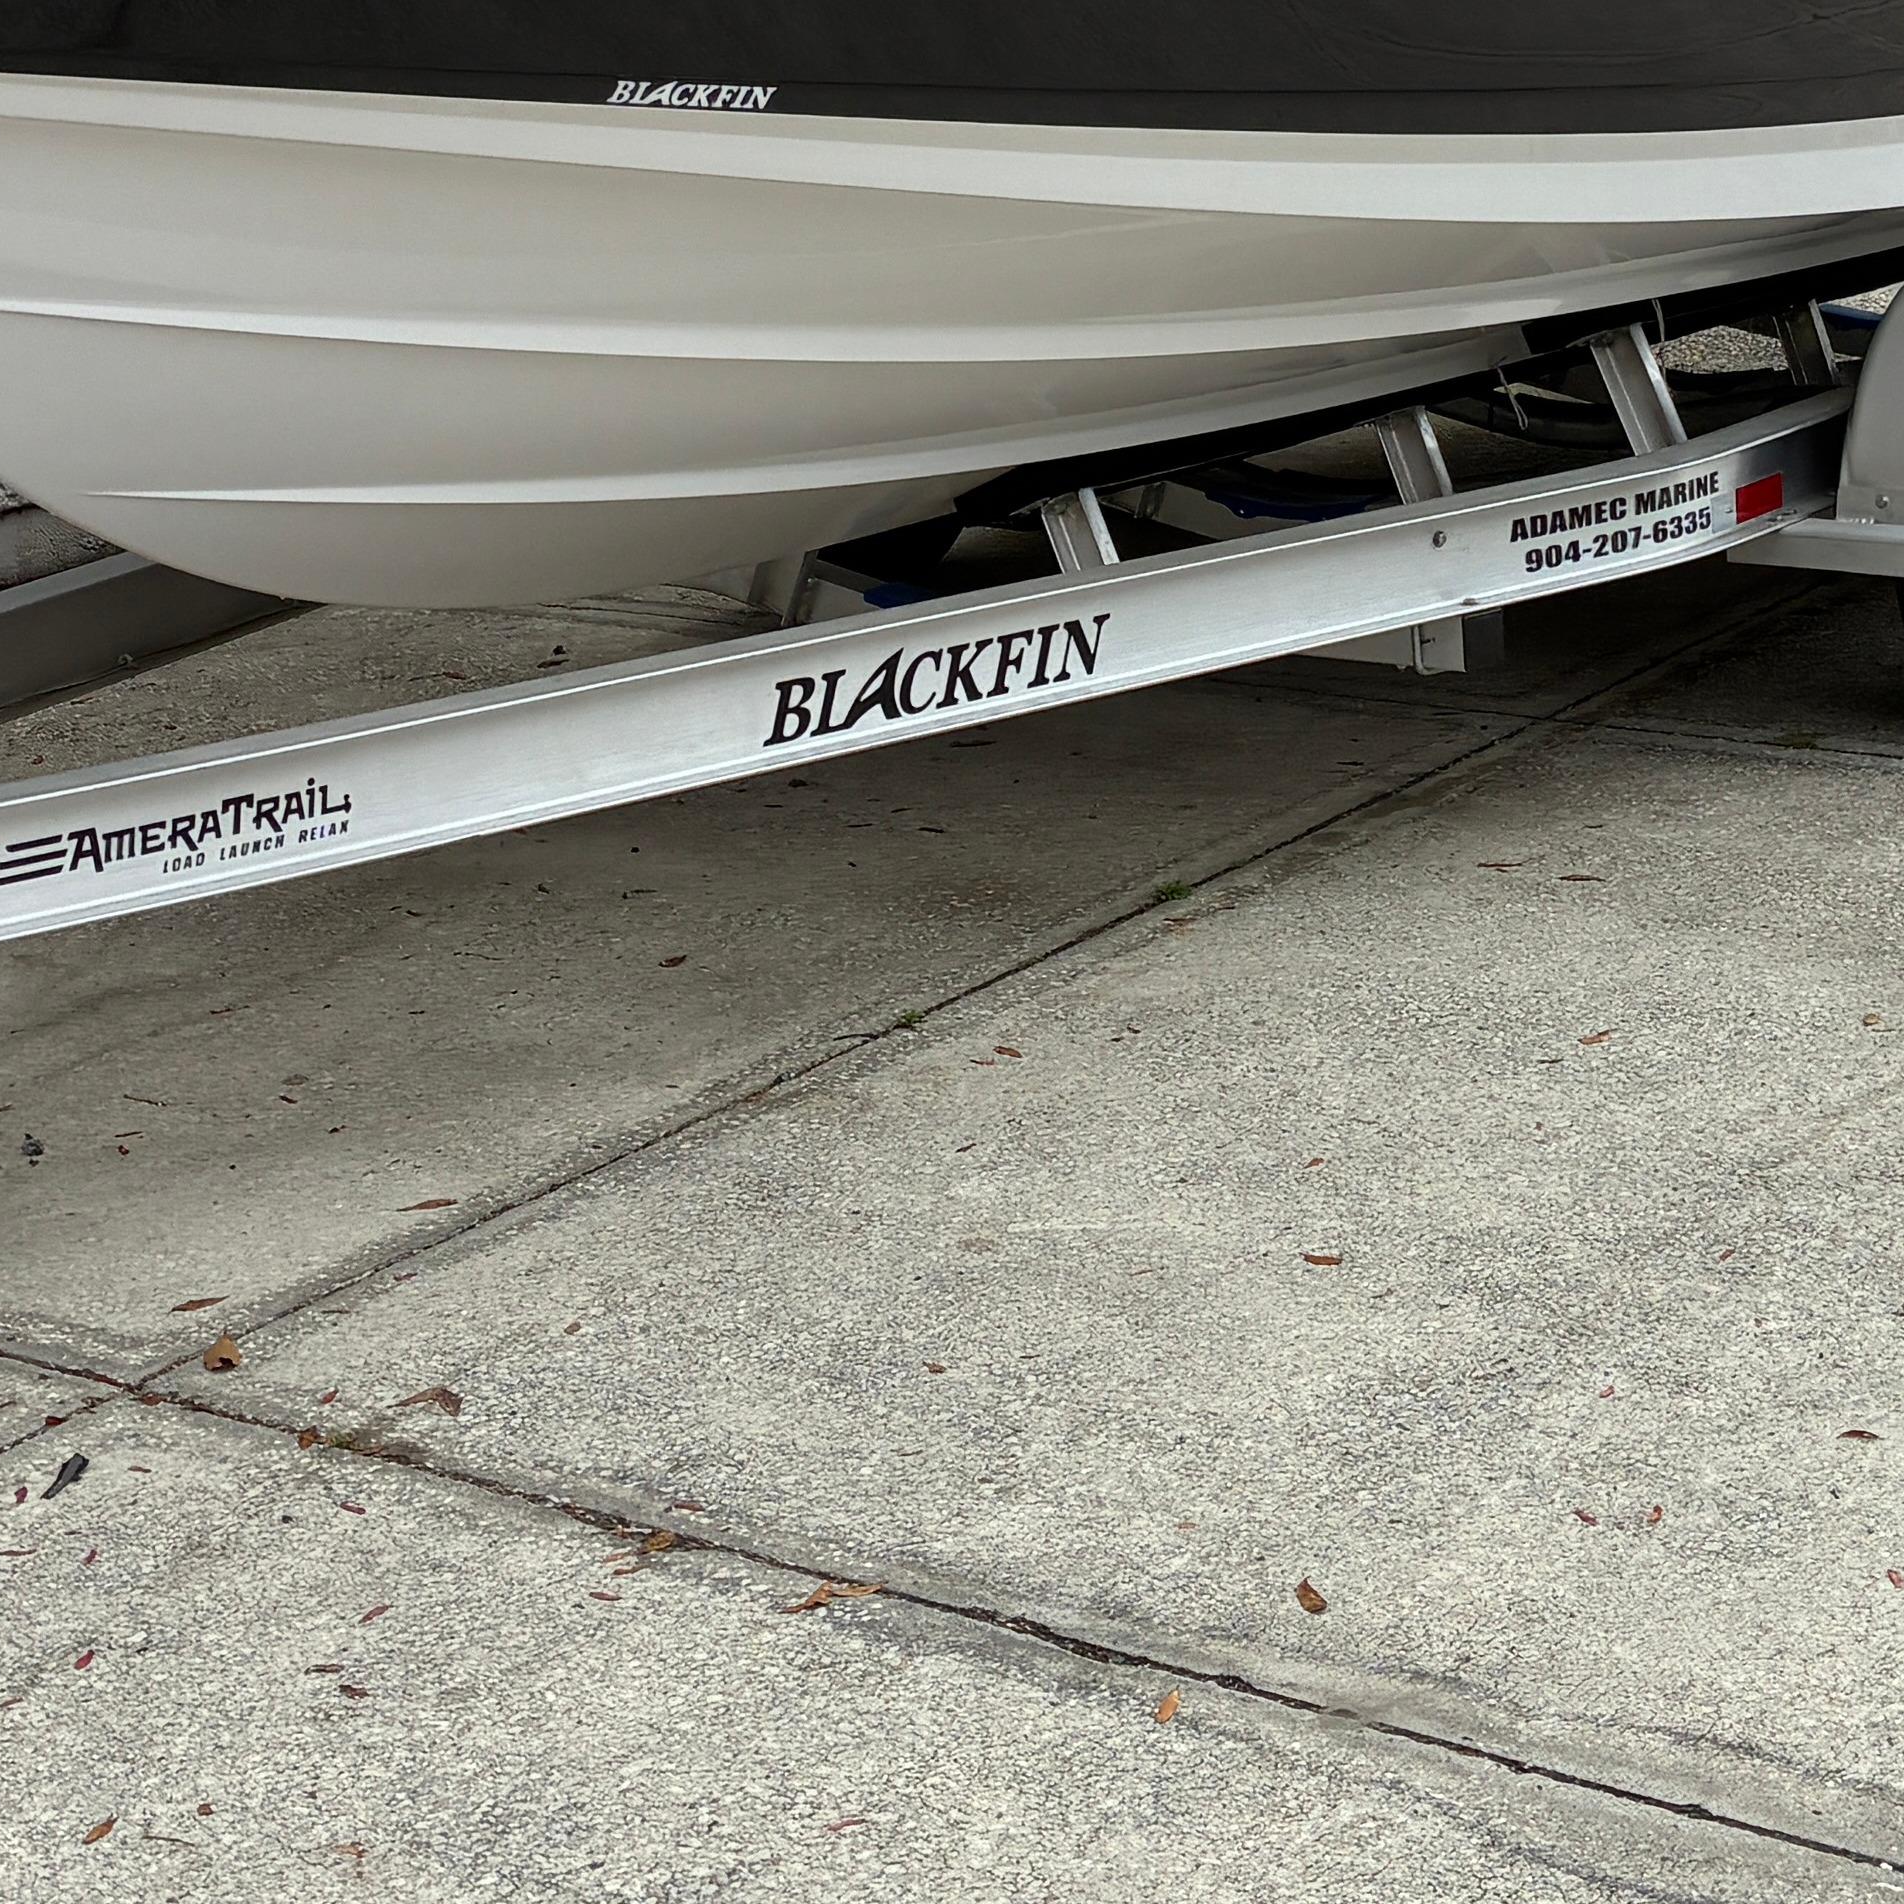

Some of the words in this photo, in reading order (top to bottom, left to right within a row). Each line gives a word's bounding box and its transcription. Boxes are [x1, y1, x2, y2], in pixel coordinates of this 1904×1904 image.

[606, 80, 778, 110] BLACKFIN
[1510, 497, 1627, 543] ADAMEC
[1635, 471, 1720, 516] MARINE
[1525, 506, 1712, 573] 904-207-6335
[763, 613, 1110, 747] BLACKFIN
[163, 852, 206, 874] LOAD
[219, 834, 285, 861] LAUNCH
[298, 819, 350, 844] RELAX
